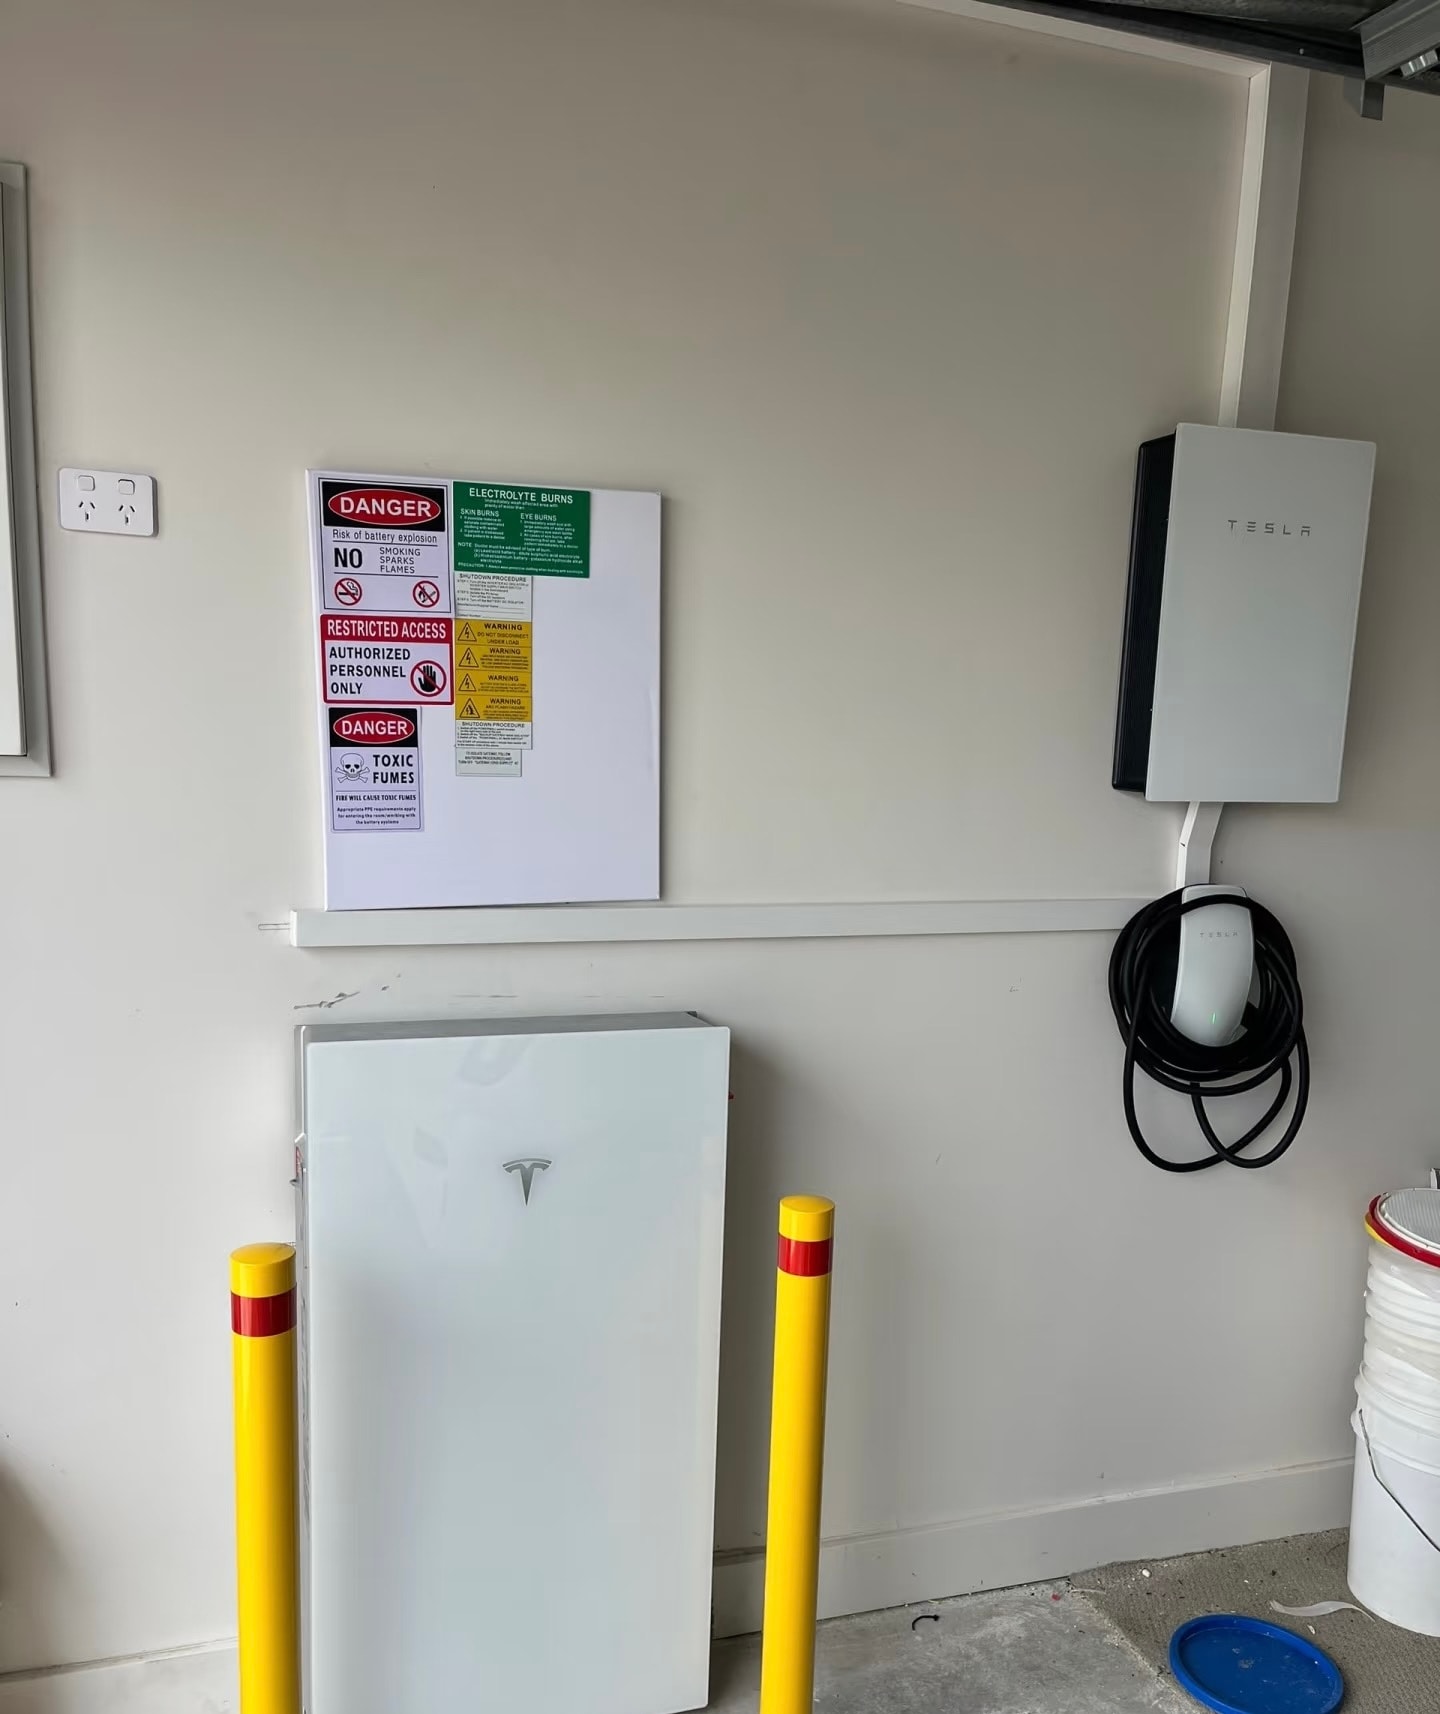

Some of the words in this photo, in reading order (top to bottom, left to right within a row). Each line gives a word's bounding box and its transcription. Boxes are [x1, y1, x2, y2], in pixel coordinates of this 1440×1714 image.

[470, 488, 536, 502] ELECTROLYTE
[541, 493, 573, 504] BURNS
[340, 496, 431, 517] DANGER
[534, 514, 557, 522] BURNS
[1228, 520, 1310, 536] TESLA
[333, 529, 350, 539] Risk
[354, 531, 362, 540] of
[365, 530, 395, 543] battery
[398, 533, 437, 544] explosion
[334, 547, 362, 568] NO
[380, 547, 420, 556] SMOKING
[380, 556, 414, 564] SPARKS
[380, 565, 414, 574] FLAMES
[328, 619, 398, 638] RESTRICTED
[402, 622, 446, 639] ACCESS
[330, 646, 410, 660] AUTHORIZED
[330, 664, 406, 678] PERSONNEL
[331, 682, 362, 694] ONLY
[342, 720, 408, 735] DANGER
[373, 754, 413, 767] TOXIC
[373, 772, 414, 784] FUMES
